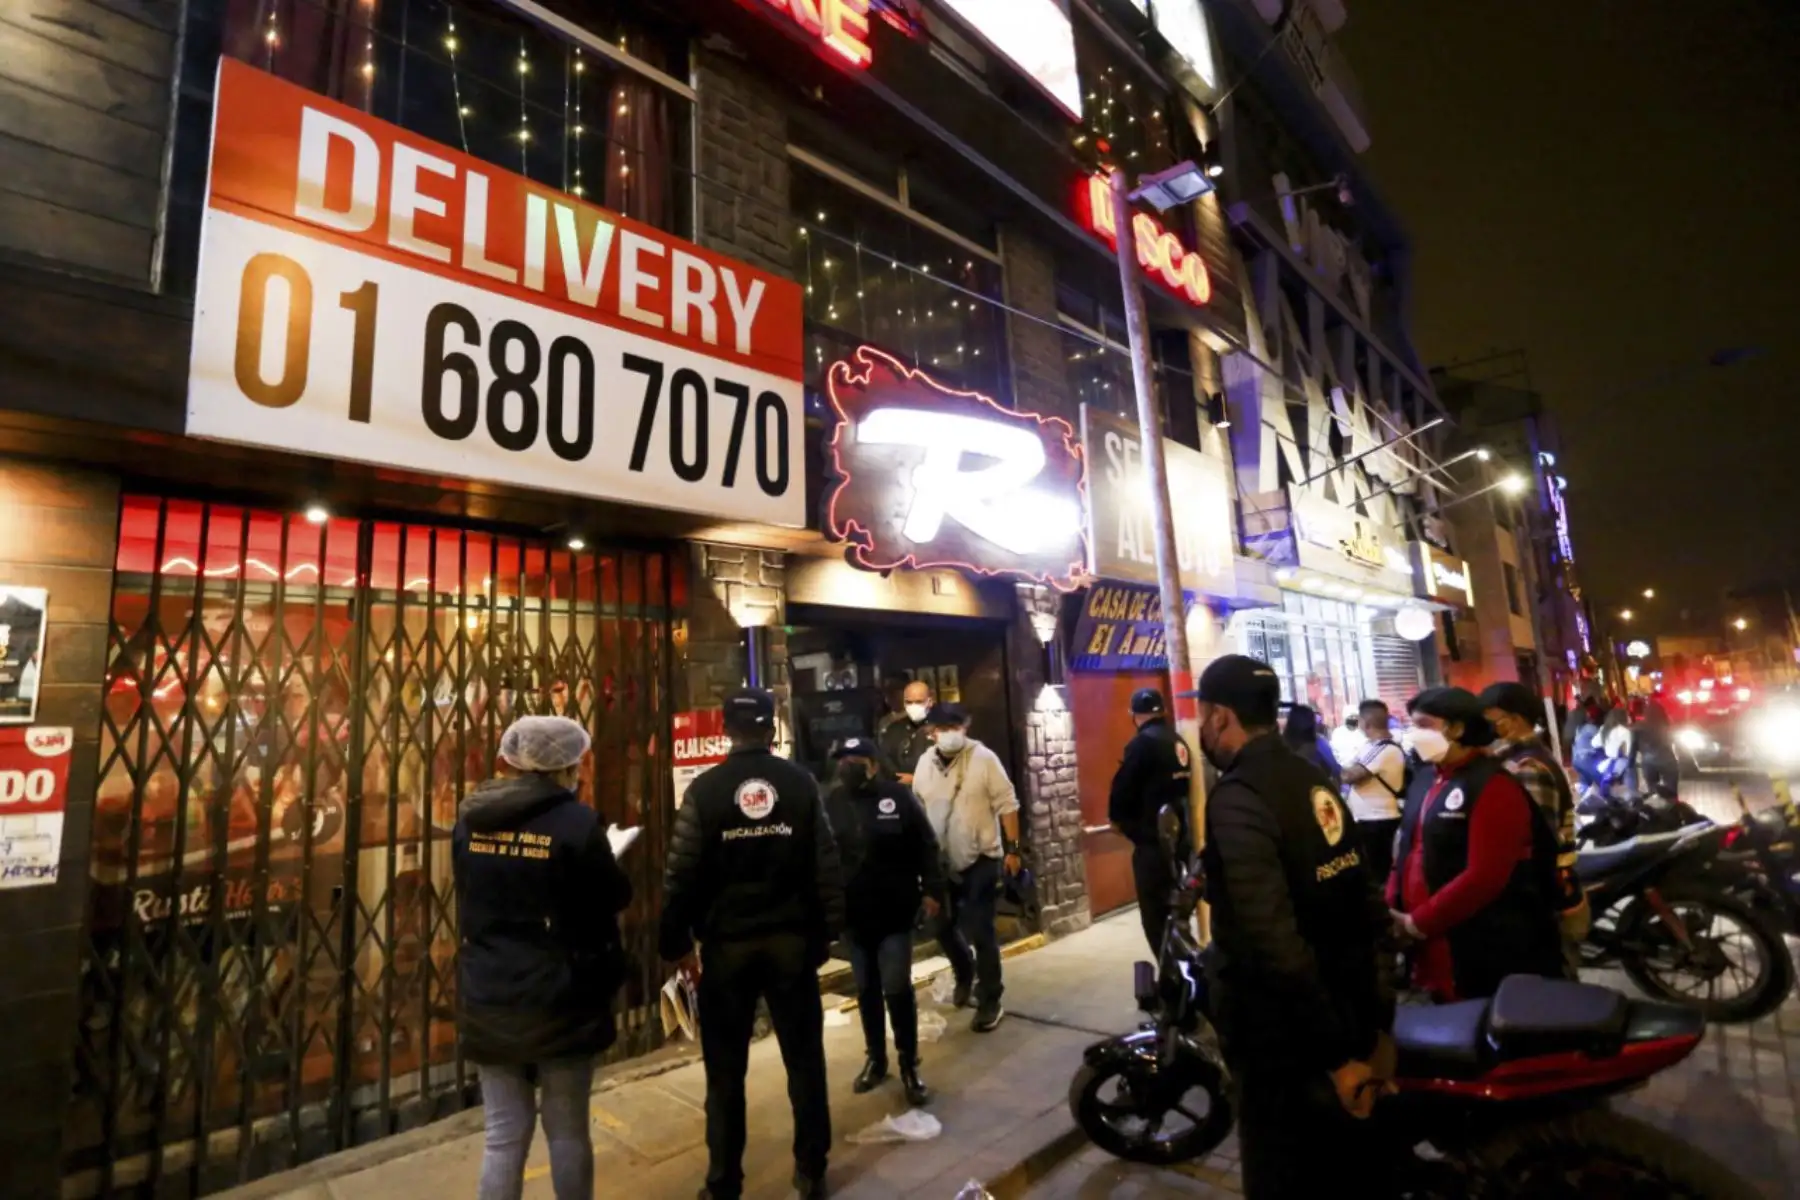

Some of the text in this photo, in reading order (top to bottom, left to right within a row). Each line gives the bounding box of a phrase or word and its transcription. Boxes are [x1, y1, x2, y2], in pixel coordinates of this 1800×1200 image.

[296, 106, 766, 355] DELIVERY
[1088, 175, 1211, 304] DSCO
[234, 252, 789, 498] 01 680 7070
[1089, 586, 1129, 619] CASA
